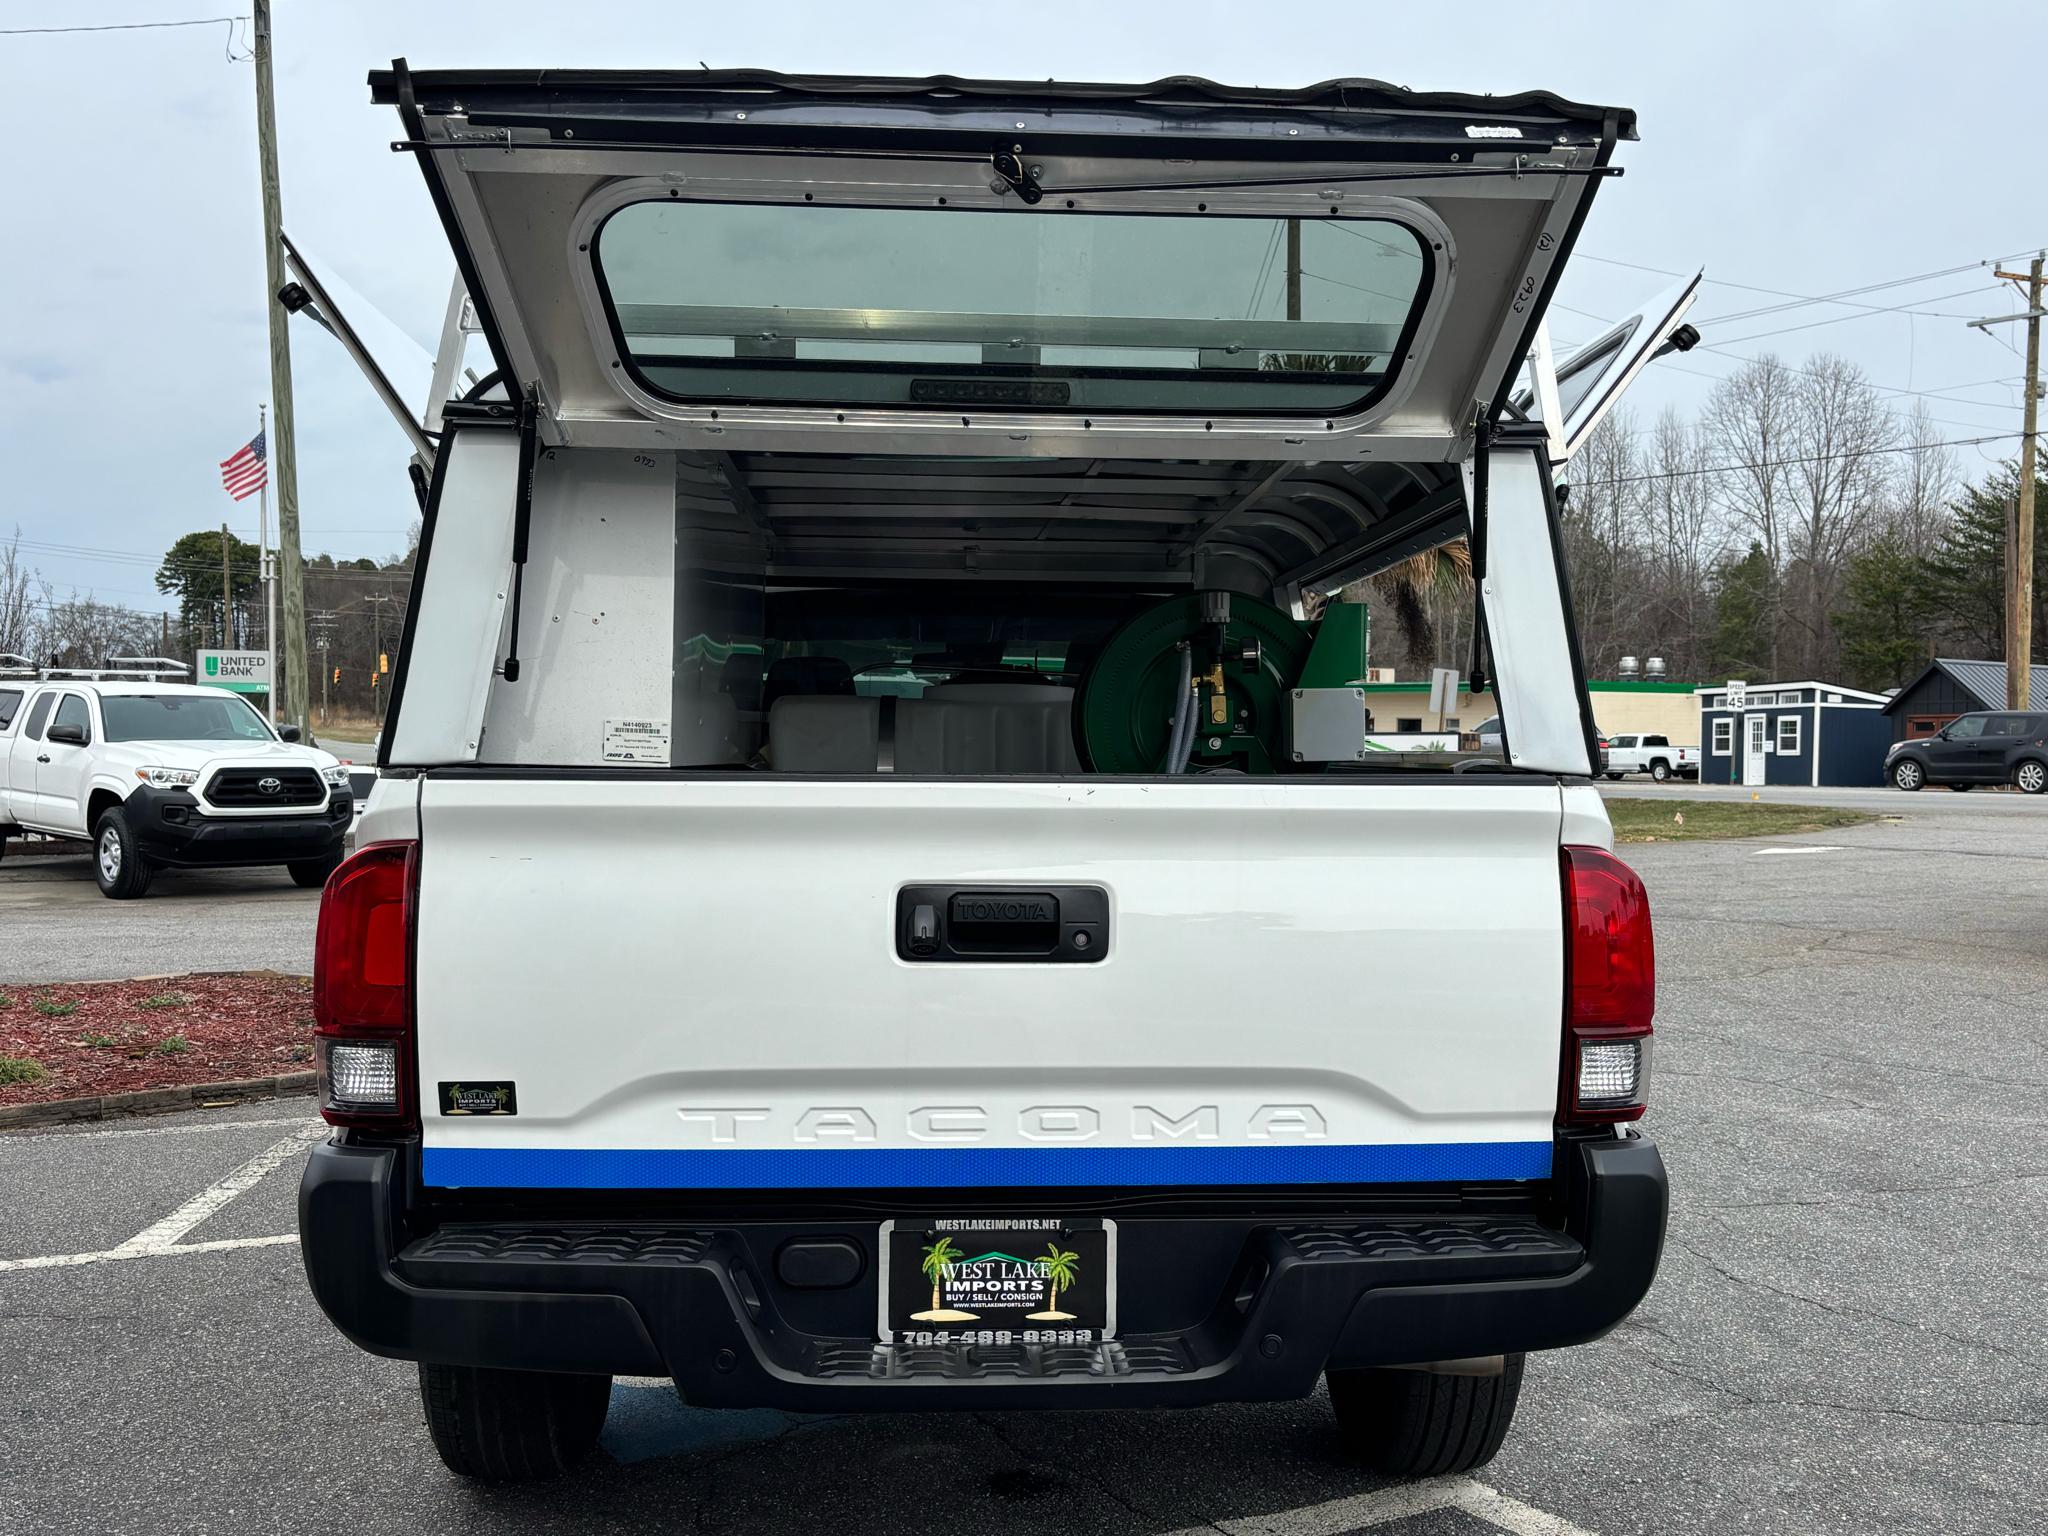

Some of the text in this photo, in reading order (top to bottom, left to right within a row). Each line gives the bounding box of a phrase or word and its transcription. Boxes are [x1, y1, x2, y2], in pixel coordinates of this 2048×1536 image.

[1513, 276, 1534, 313] 0923
[220, 656, 266, 667] UNITED
[220, 667, 253, 676] BANK
[1728, 697, 1743, 708] 45
[959, 902, 1049, 920] TOYOTA
[677, 1104, 1327, 1143] TACOMA
[935, 1219, 1062, 1230] WESTLAKEIMPORTS.NET
[940, 1262, 1051, 1279] WEST LAKE
[945, 1280, 1044, 1291] IMPORTS
[946, 1293, 964, 1301] BUY
[973, 1293, 993, 1301] SELL
[902, 1330, 1093, 1345] 704-489-9333
